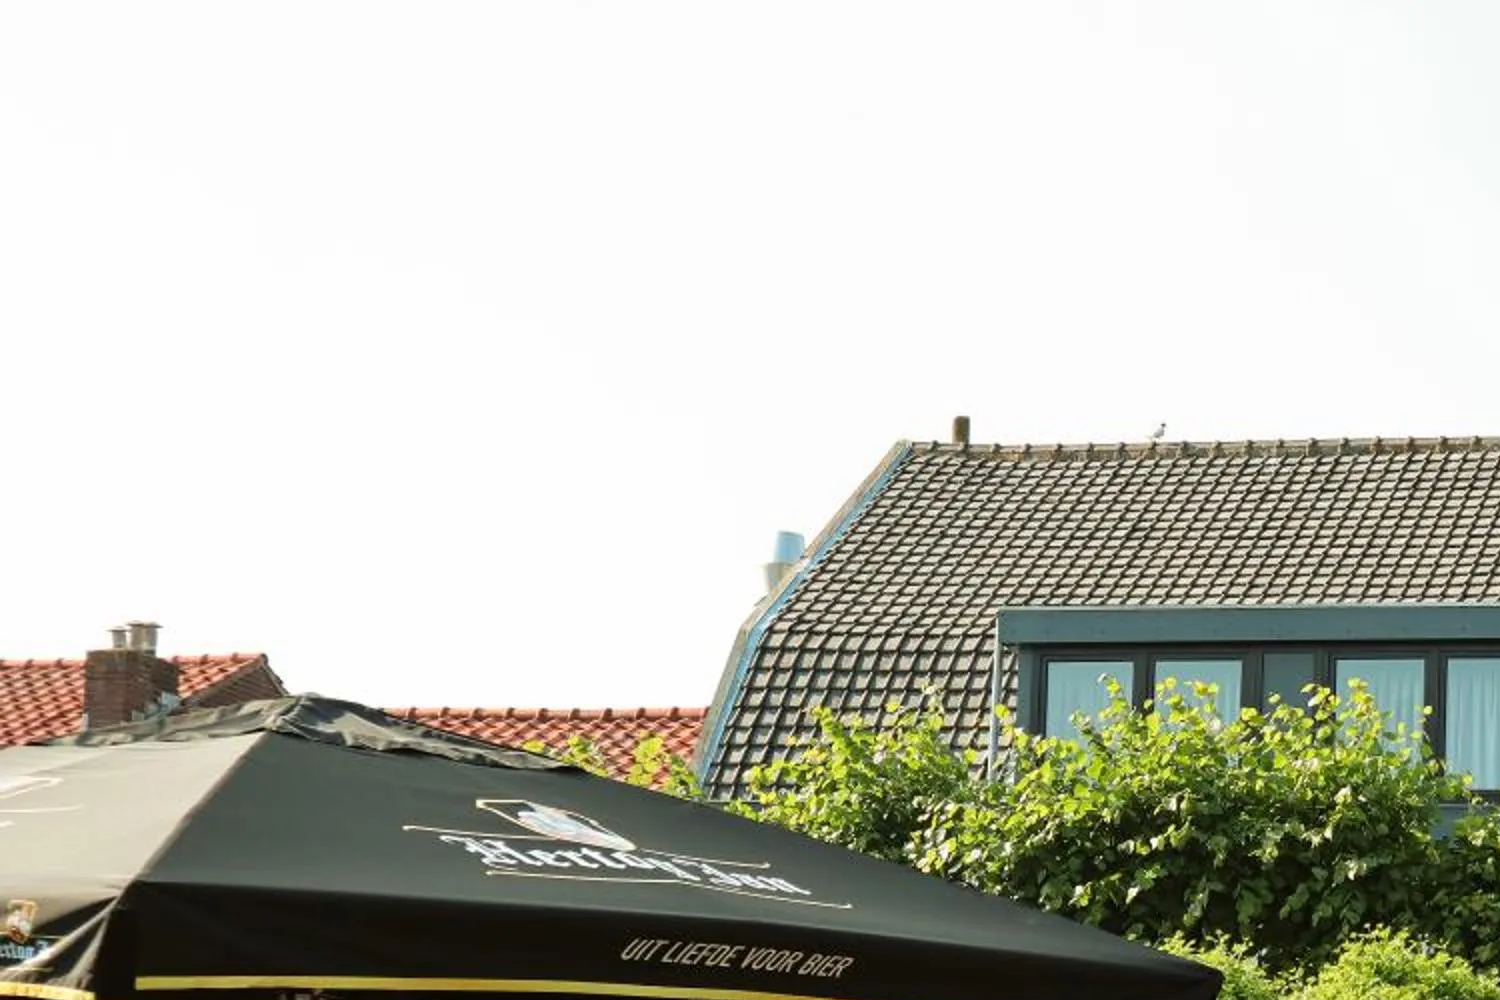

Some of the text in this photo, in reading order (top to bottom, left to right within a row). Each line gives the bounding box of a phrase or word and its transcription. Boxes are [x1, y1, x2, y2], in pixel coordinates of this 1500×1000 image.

[620, 937, 855, 978] UIT LIEFDE VOOR BIER
